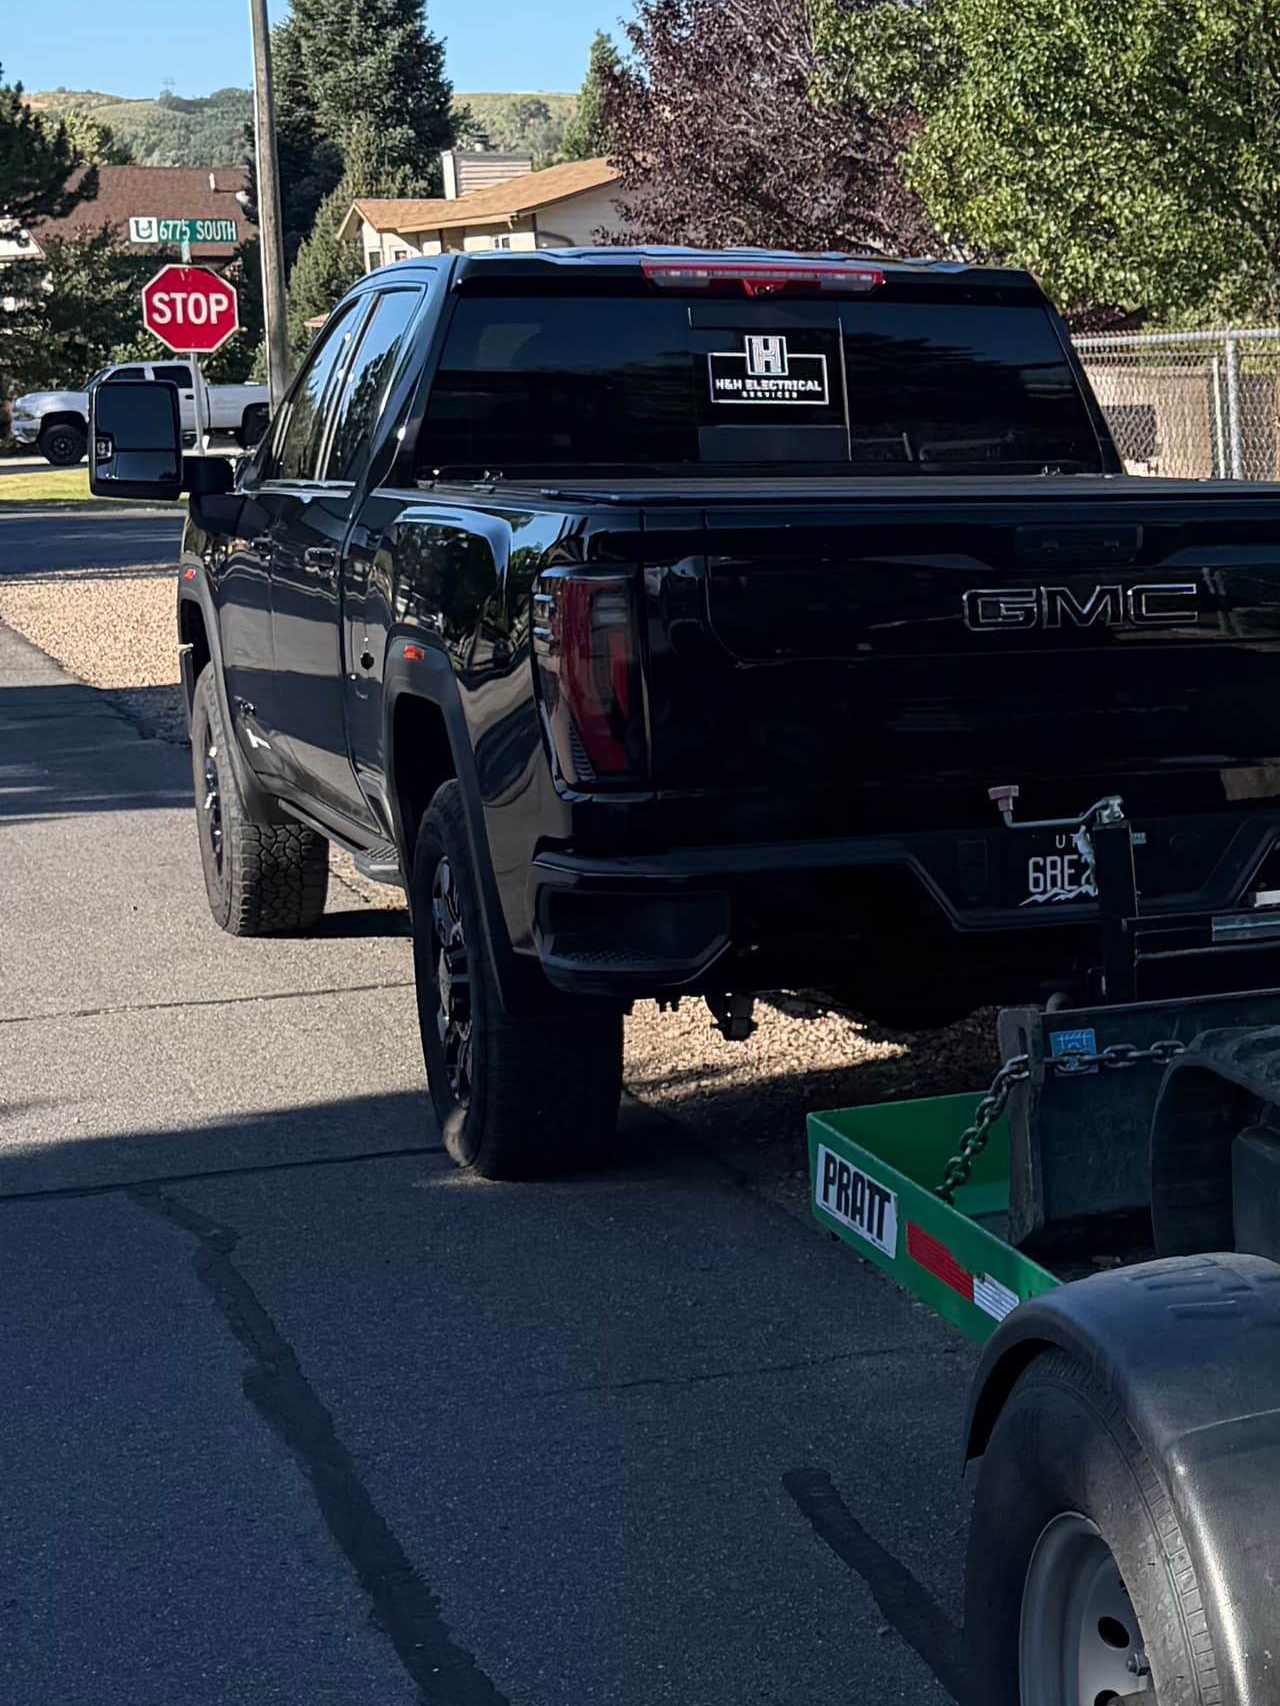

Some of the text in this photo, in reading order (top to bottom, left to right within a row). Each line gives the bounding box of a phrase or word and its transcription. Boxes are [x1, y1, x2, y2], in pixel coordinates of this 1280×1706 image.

[159, 220, 237, 241] 6775 SOUTH
[151, 292, 229, 325] STOP
[715, 379, 822, 391] H&H ELECTRICAL
[962, 583, 1198, 632] GMC
[822, 1150, 892, 1243] PRATT
